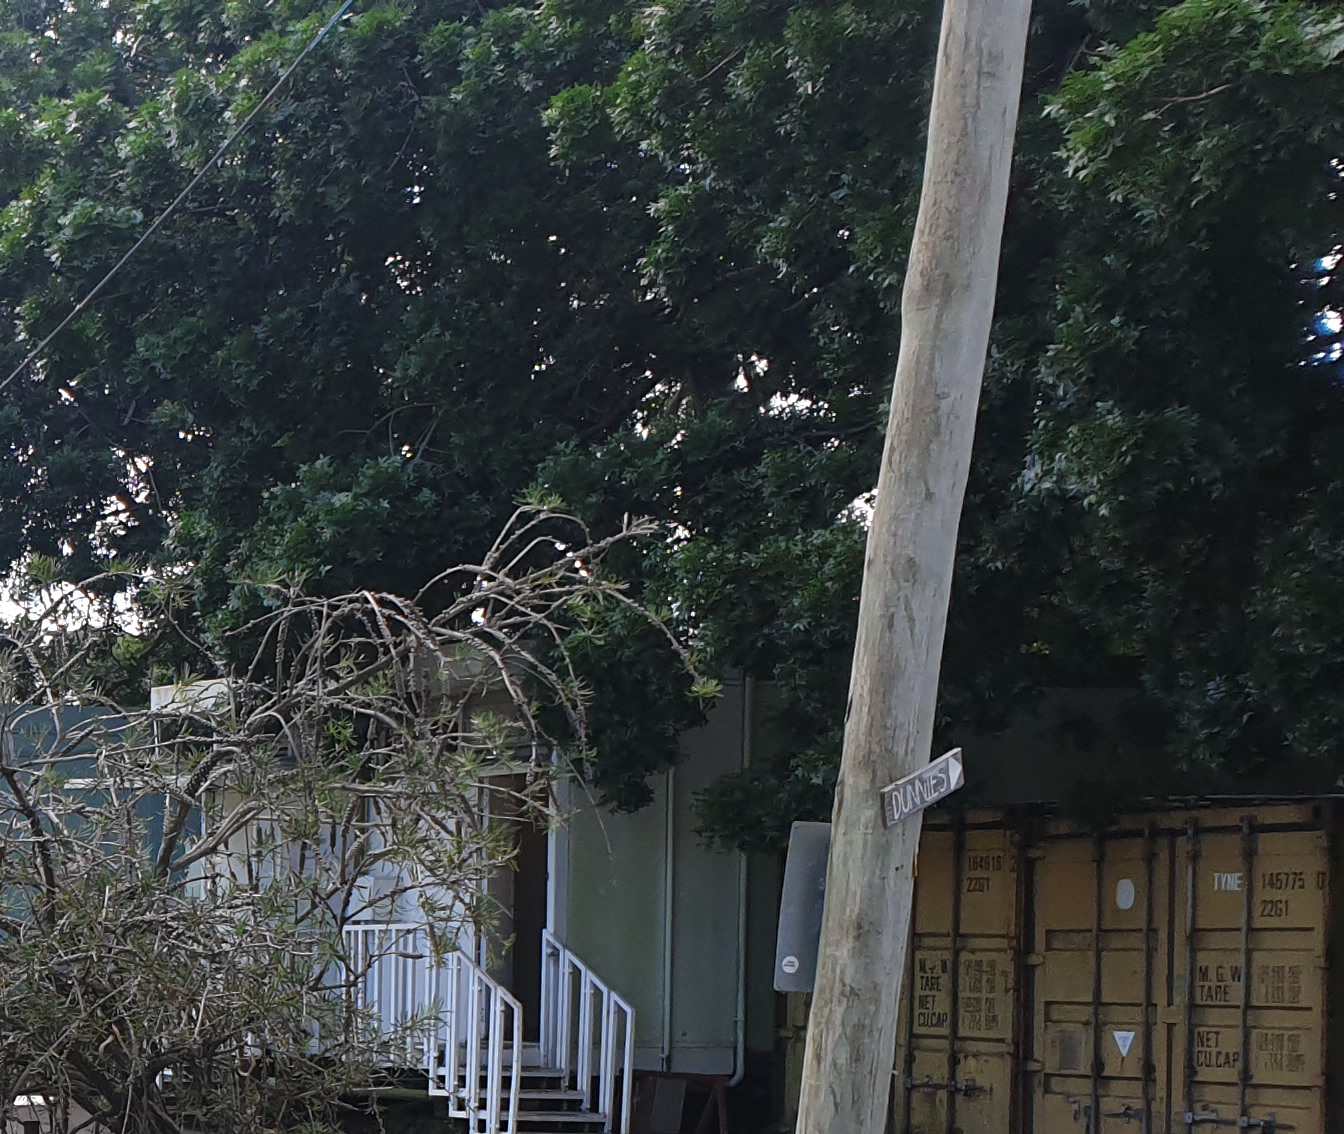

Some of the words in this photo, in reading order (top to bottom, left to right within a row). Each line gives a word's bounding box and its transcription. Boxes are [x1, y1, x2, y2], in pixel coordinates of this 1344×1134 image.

[892, 768, 947, 820] DUNNIES
[1213, 872, 1243, 891] TYNE
[1196, 1030, 1220, 1048] NET
